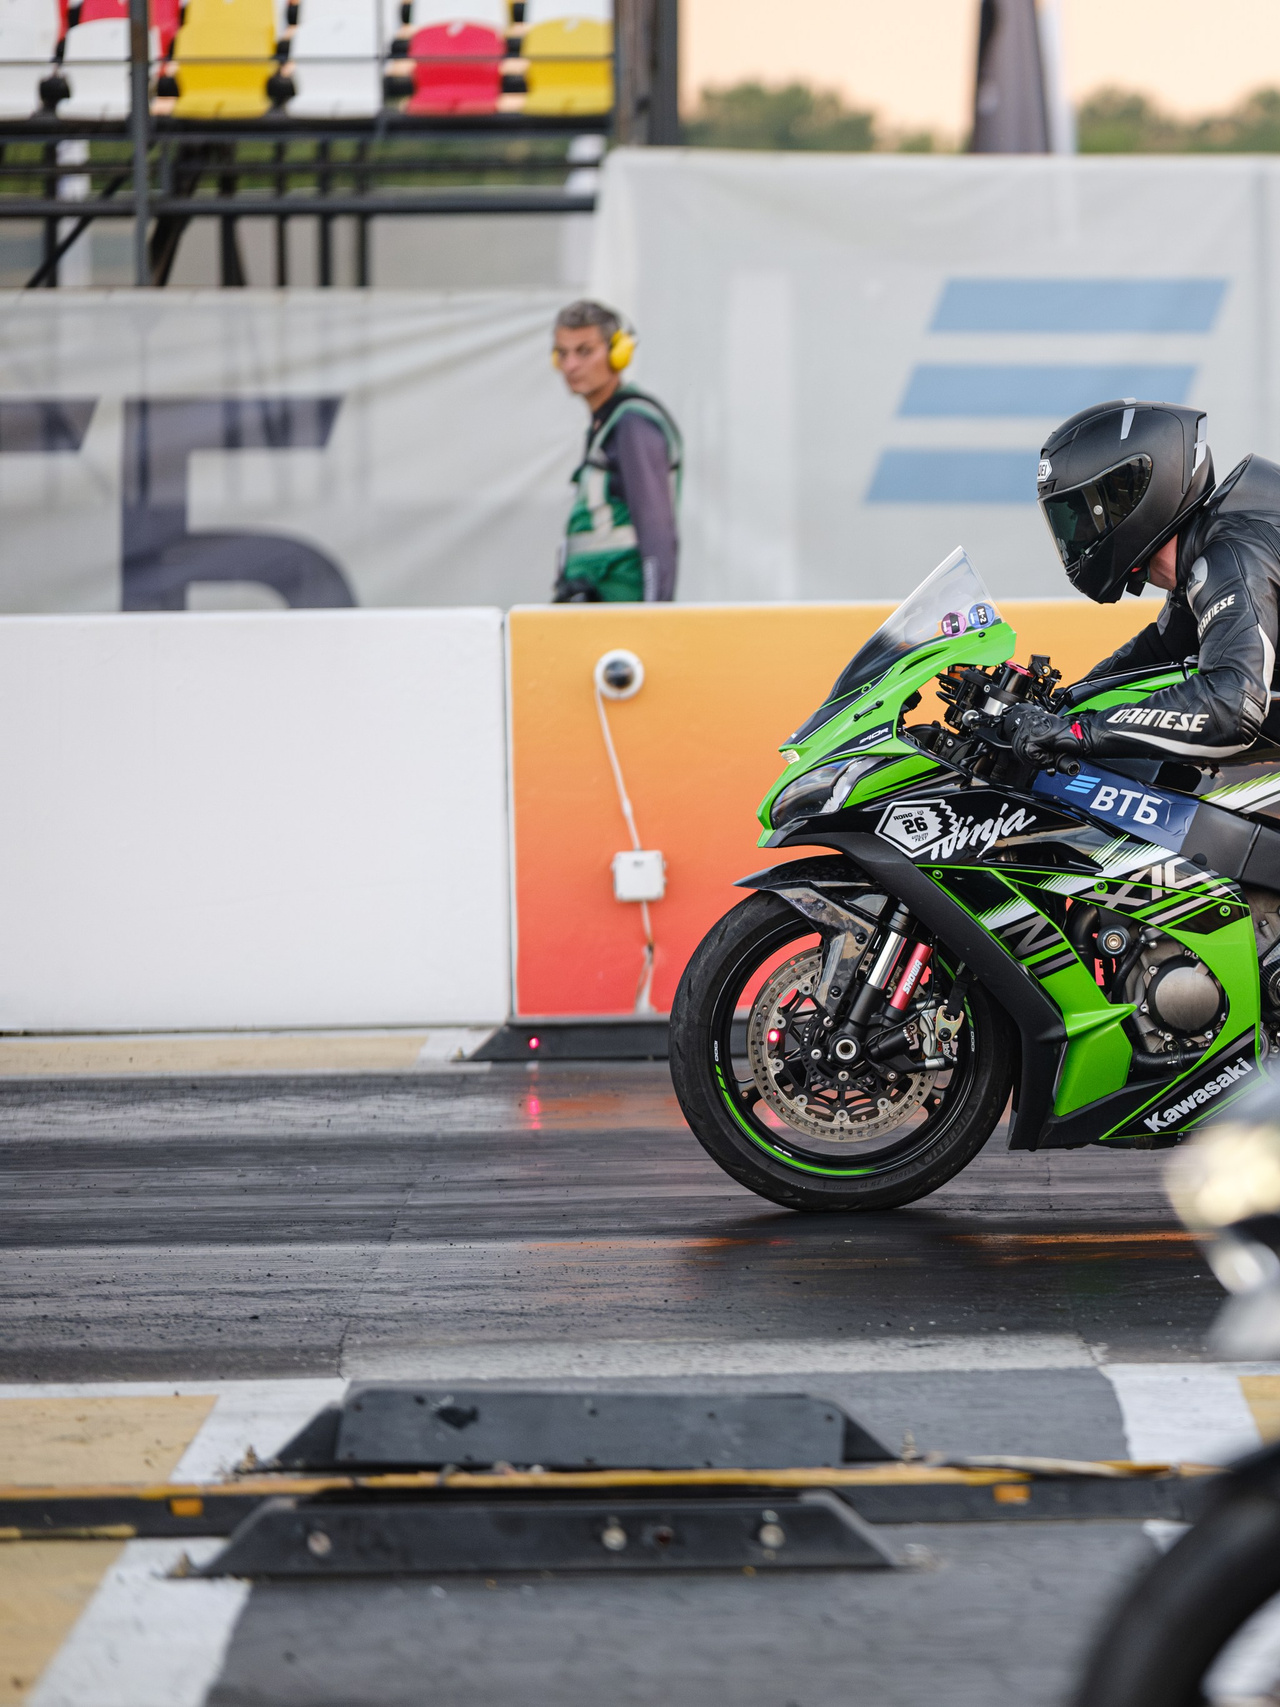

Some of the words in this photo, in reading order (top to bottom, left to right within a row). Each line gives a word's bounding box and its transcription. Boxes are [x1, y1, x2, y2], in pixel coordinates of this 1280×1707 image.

[1106, 708, 1209, 732] DAINESE
[1089, 785, 1163, 825] ВТБ
[902, 817, 929, 835] 26
[902, 959, 923, 995] SHOWA
[1143, 1057, 1254, 1133] Kawasaki
